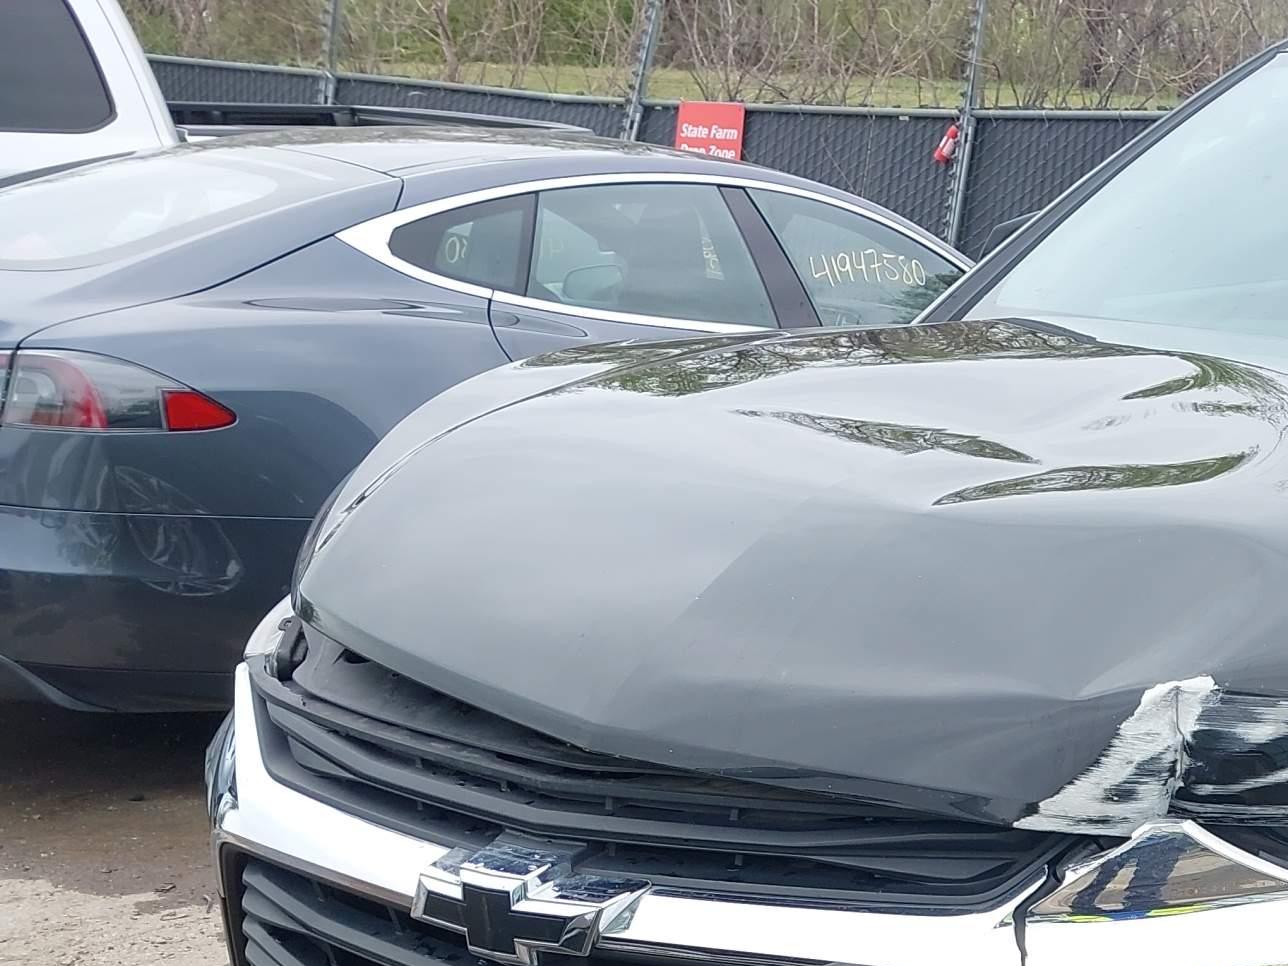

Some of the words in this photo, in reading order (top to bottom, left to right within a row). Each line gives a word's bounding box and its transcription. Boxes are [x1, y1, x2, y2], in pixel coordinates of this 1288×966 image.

[680, 123, 709, 138] State
[710, 124, 738, 140] Farm
[706, 145, 736, 159] Zone
[809, 249, 926, 287] 41947580
